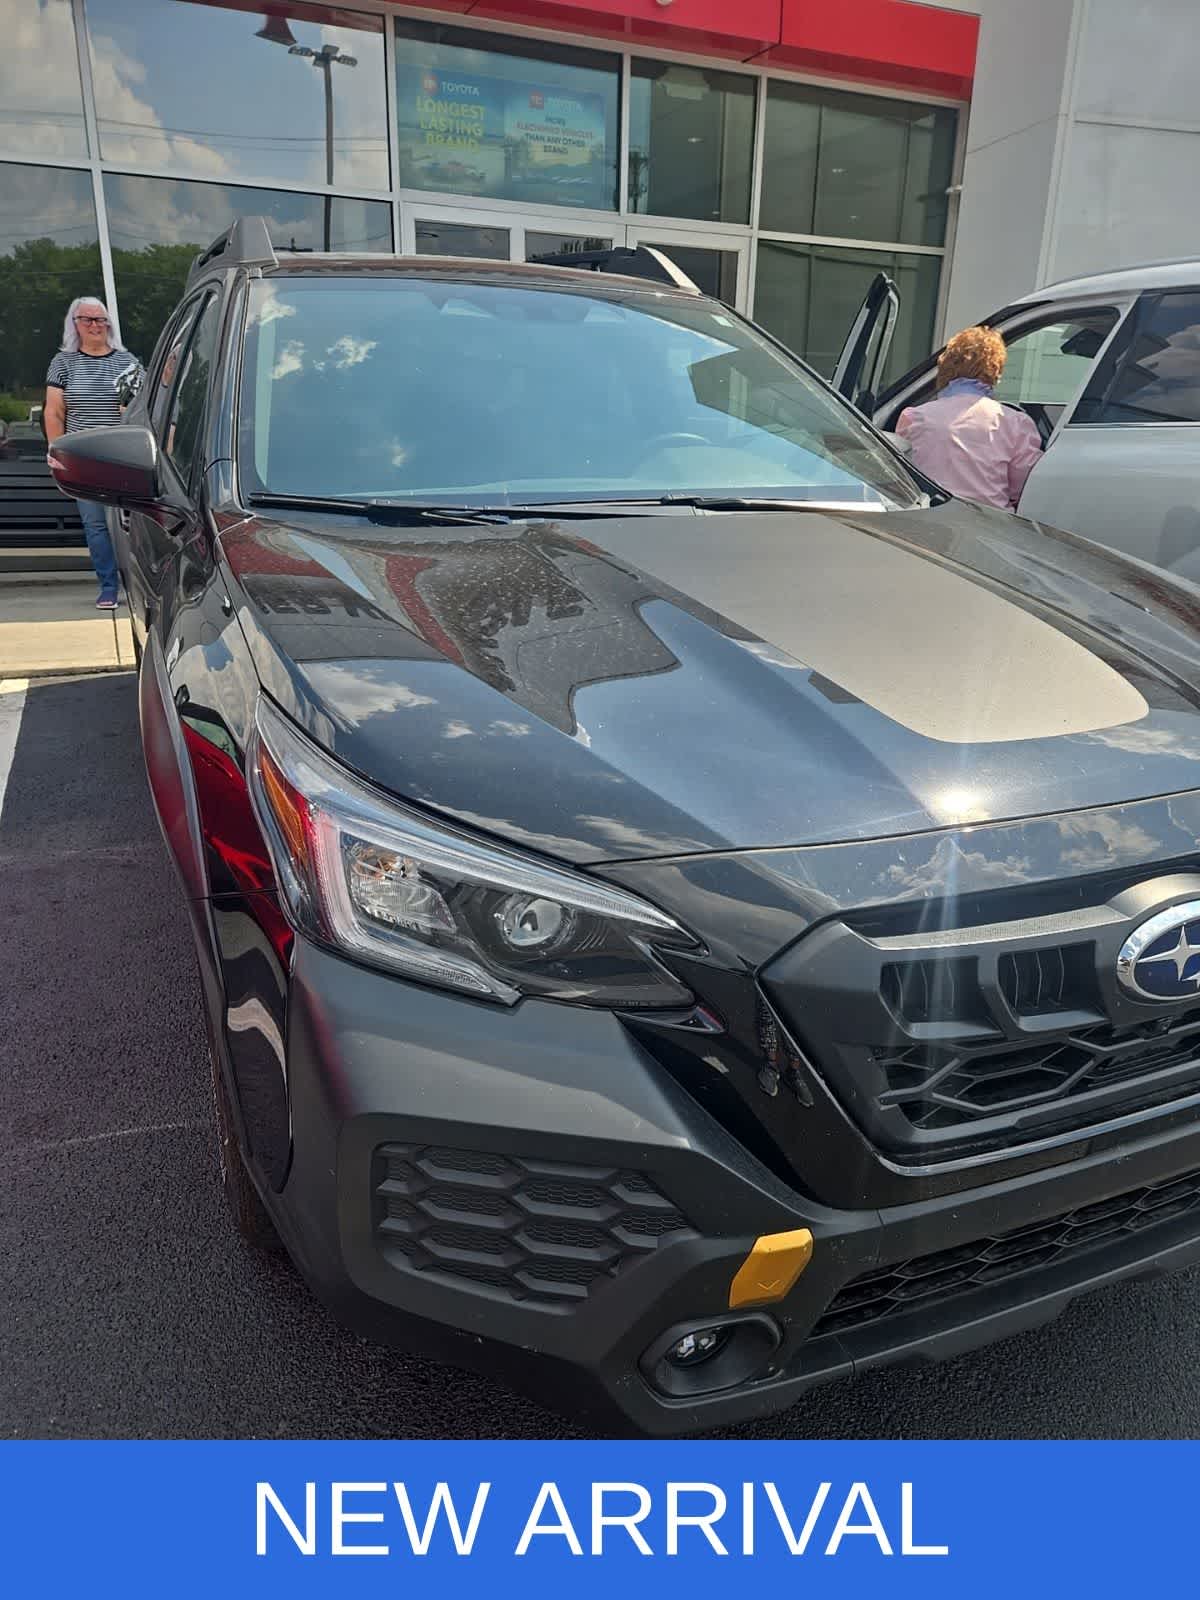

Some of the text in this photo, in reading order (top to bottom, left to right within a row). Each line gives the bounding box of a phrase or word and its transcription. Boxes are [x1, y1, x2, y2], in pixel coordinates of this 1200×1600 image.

[441, 81, 480, 97] TOYOTA
[416, 95, 485, 120] LONGEST
[419, 116, 484, 137] LASTING
[426, 133, 480, 153] BRAND
